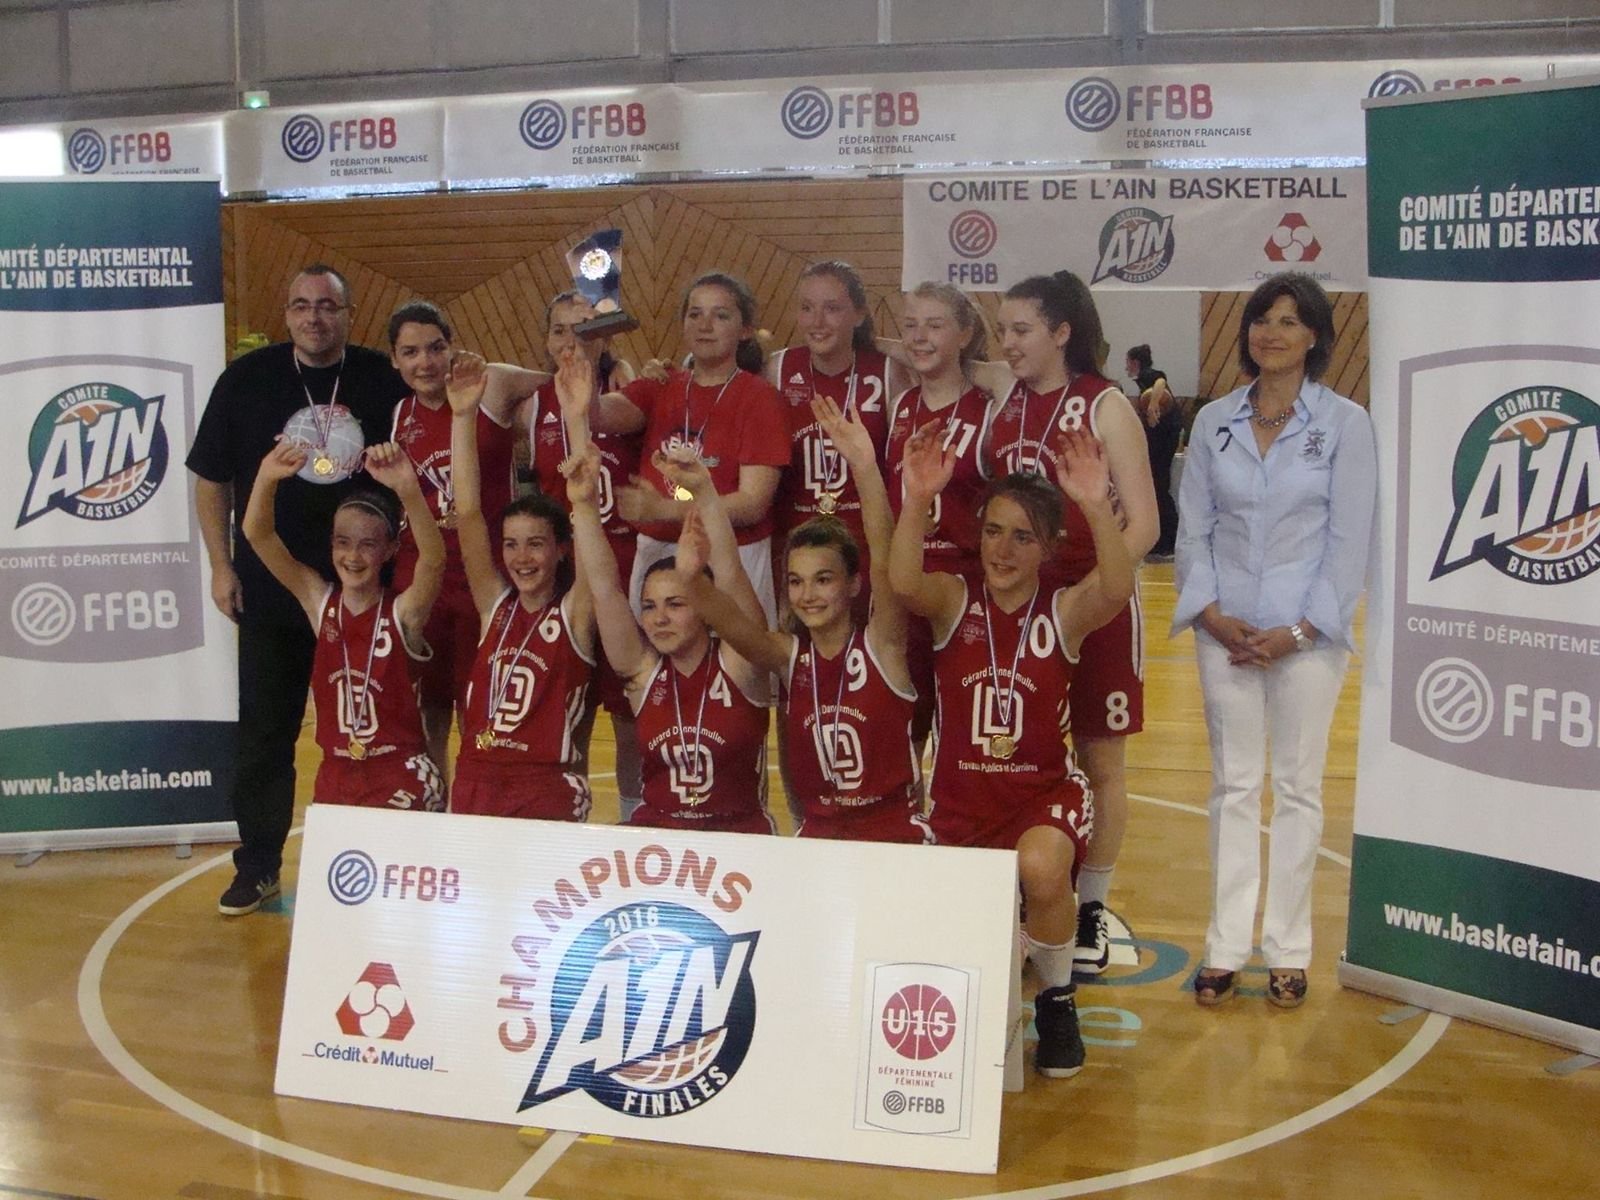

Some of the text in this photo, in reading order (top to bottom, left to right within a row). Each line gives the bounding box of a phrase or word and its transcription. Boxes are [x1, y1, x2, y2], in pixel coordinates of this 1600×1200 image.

[838, 91, 919, 128] FFBB
[1127, 83, 1213, 121] FFBB
[329, 117, 397, 152] FFBB
[572, 102, 646, 139] FFBB
[1127, 127, 1252, 138] FÉDÉRATION FRANÇAISE
[111, 131, 171, 165] FFBB
[572, 143, 680, 154] FÉDÉRATION FRANÇAISE
[838, 133, 957, 145] FÉDÉRATION FRANÇAISE
[838, 146, 913, 155] DE BASKETBALL
[1127, 139, 1207, 149] DE BASKETBALL
[330, 167, 393, 177] DE BASKETBALL
[383, 155, 429, 164] FRANÇAISE
[572, 155, 642, 165] DE BASKETBALL
[928, 177, 1347, 202] COMITE DE L'AIN BASKETBALL
[1400, 185, 1482, 222] COMITÉ
[1400, 218, 1600, 251] DE L'AIN DE BASK
[44, 243, 193, 268] DÉPARTEMENTAL
[1, 267, 193, 289] L'AIN DE BASKETBALL
[948, 263, 999, 284] FFBB
[58, 384, 109, 409] COMITE
[1494, 391, 1562, 422] COMITE
[1059, 396, 1086, 432] 8
[76, 480, 158, 519] BASKETBALL
[0, 550, 190, 568] COMITÉ DÉPARTEMENTAL
[1507, 543, 1600, 581] BASKETBA
[84, 590, 180, 632] FFBB
[539, 607, 561, 643] 6
[374, 618, 393, 657] 5
[1407, 617, 1477, 639] COMITÉ
[846, 648, 868, 691] 9
[709, 670, 733, 707] 4
[1106, 691, 1130, 731] 8
[1504, 684, 1600, 748] FFB
[2, 768, 212, 796] www.basketain.com
[383, 865, 460, 903] FFBB
[604, 906, 659, 939] 2016
[497, 844, 752, 1053] CHAMPIONS
[887, 1008, 949, 1038] U15
[314, 1042, 434, 1071] Crédit Mutuel
[878, 1066, 953, 1080] DÉPARTEMENTALE
[895, 1077, 935, 1088] FÉMININE
[623, 1065, 729, 1116] FINALES
[908, 1096, 945, 1114] FFBB
